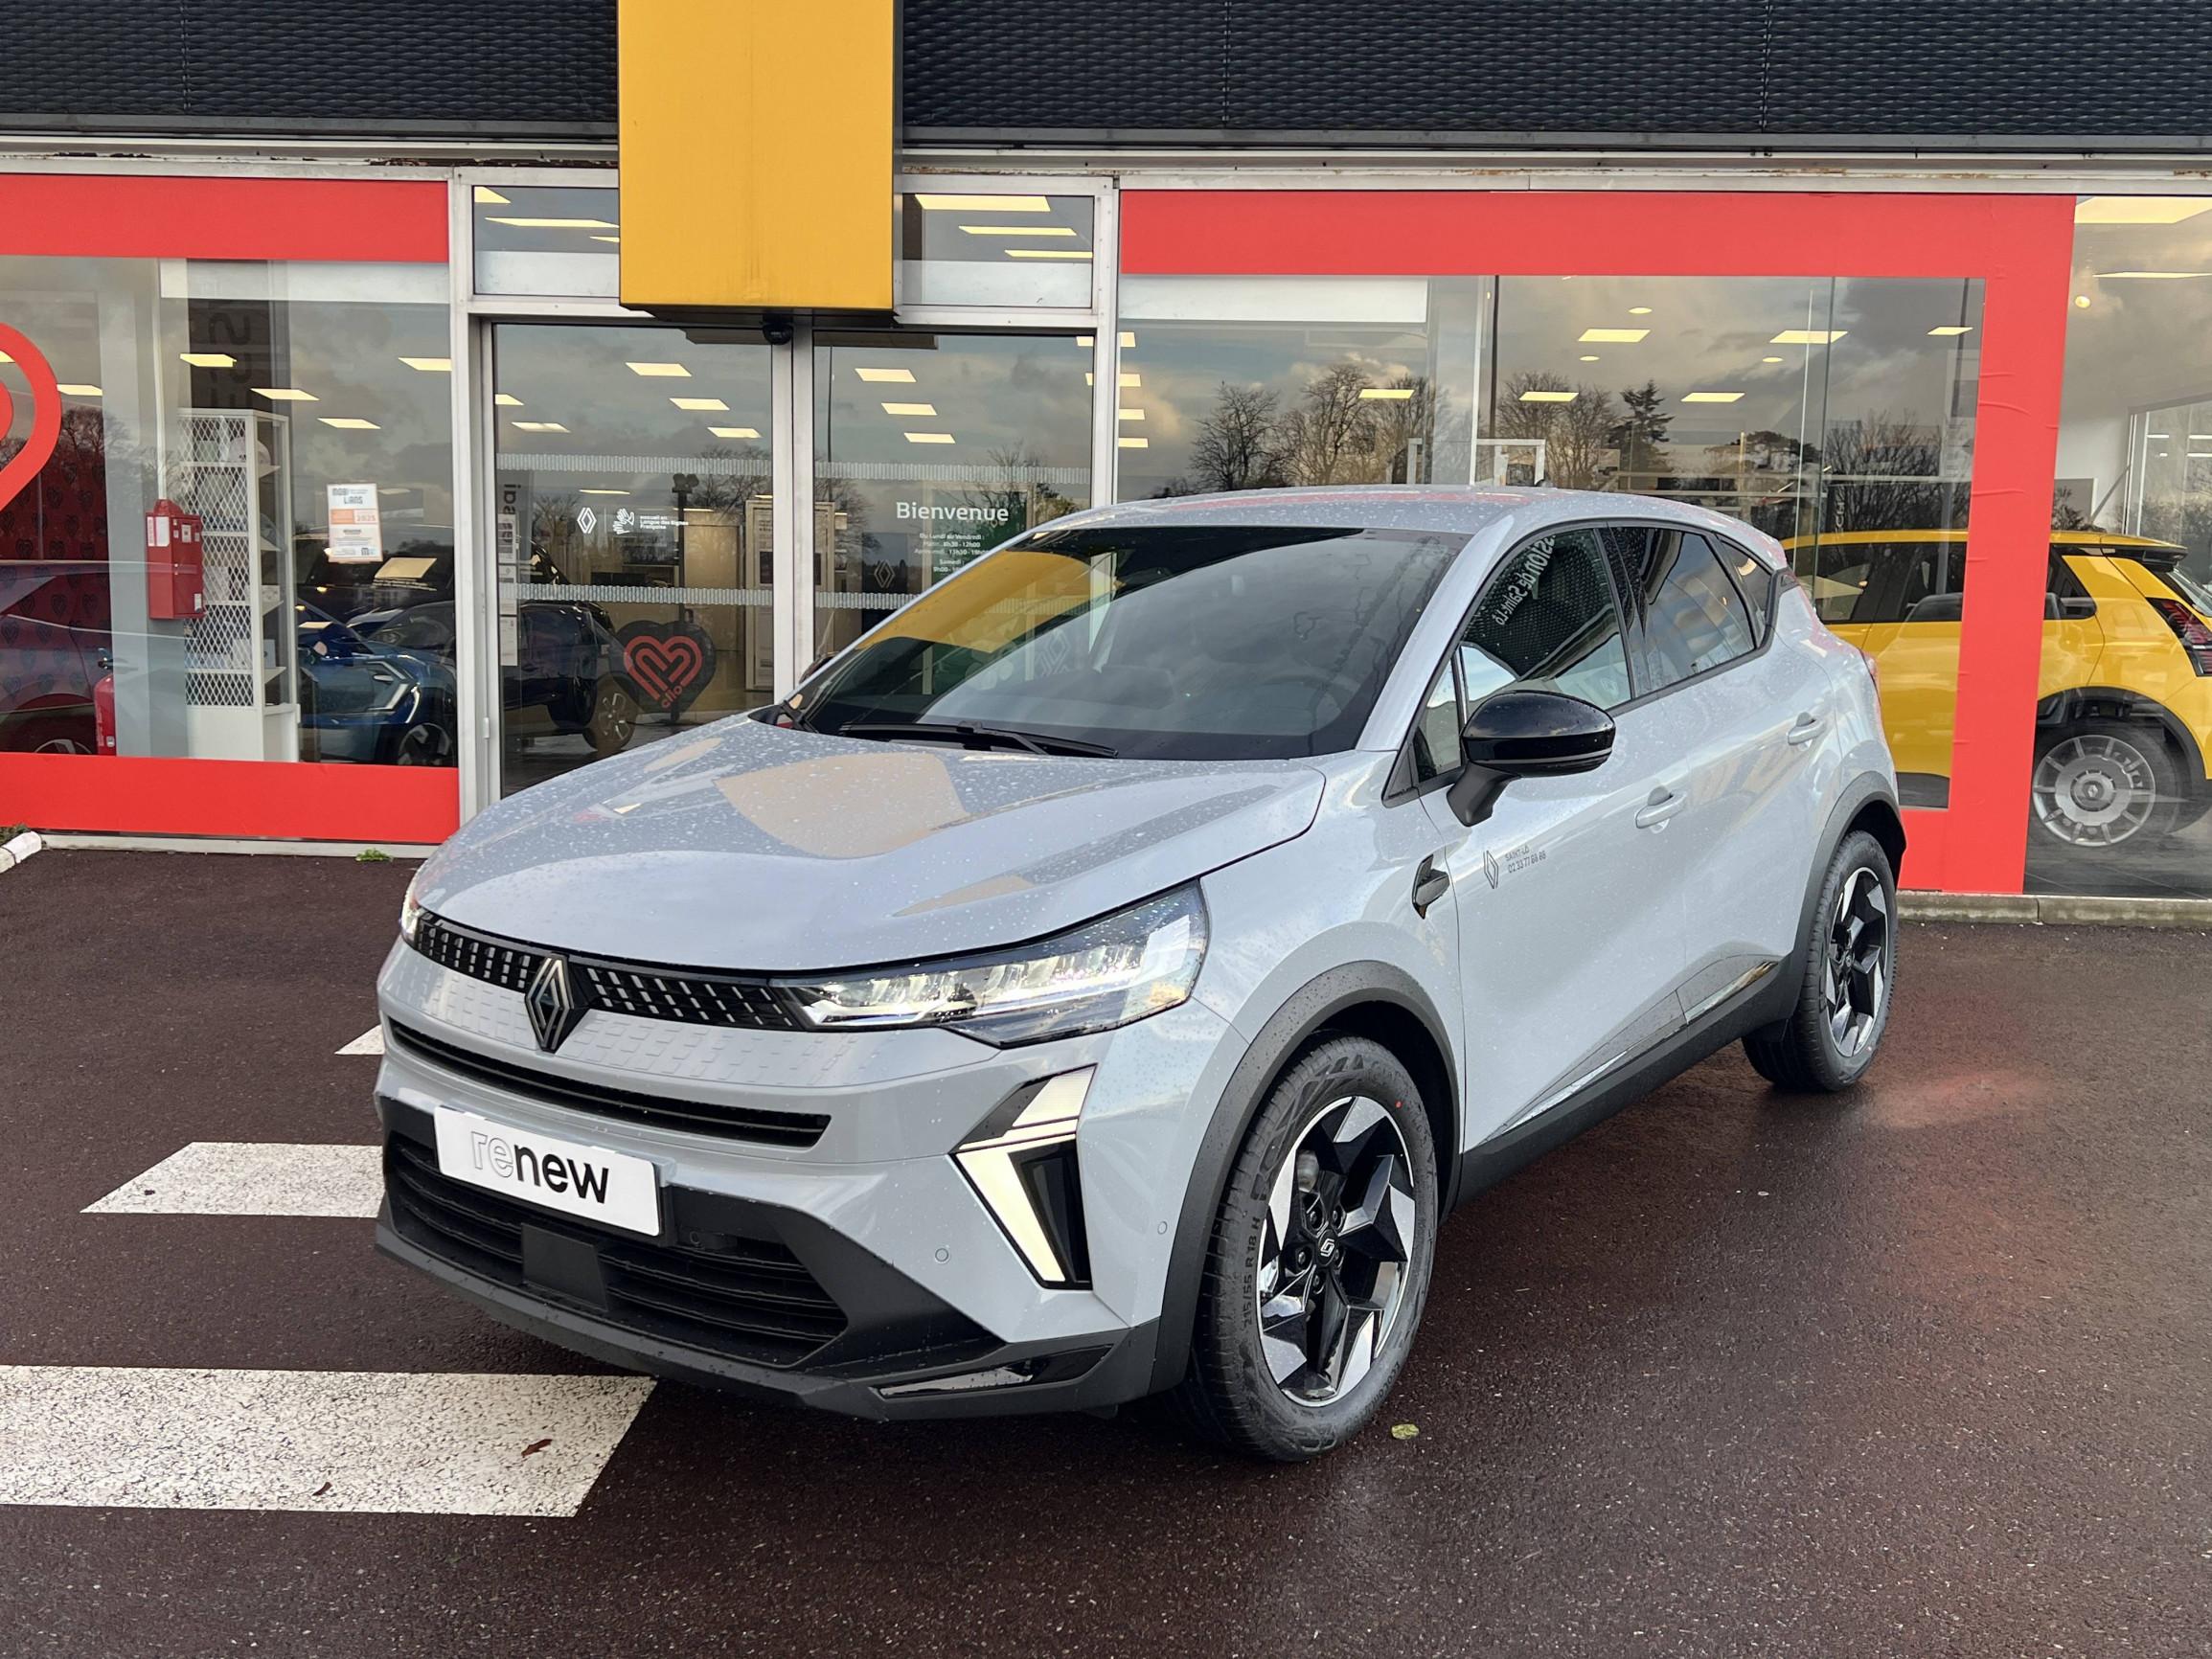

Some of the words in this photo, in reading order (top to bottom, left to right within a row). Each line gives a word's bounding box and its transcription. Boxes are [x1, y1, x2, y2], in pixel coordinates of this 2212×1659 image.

[896, 501, 1009, 522] Bienvenue
[661, 685, 683, 709] clio
[470, 1130, 609, 1204] renew
[1246, 1236, 1257, 1252] 18
[1245, 1257, 1254, 1268] R
